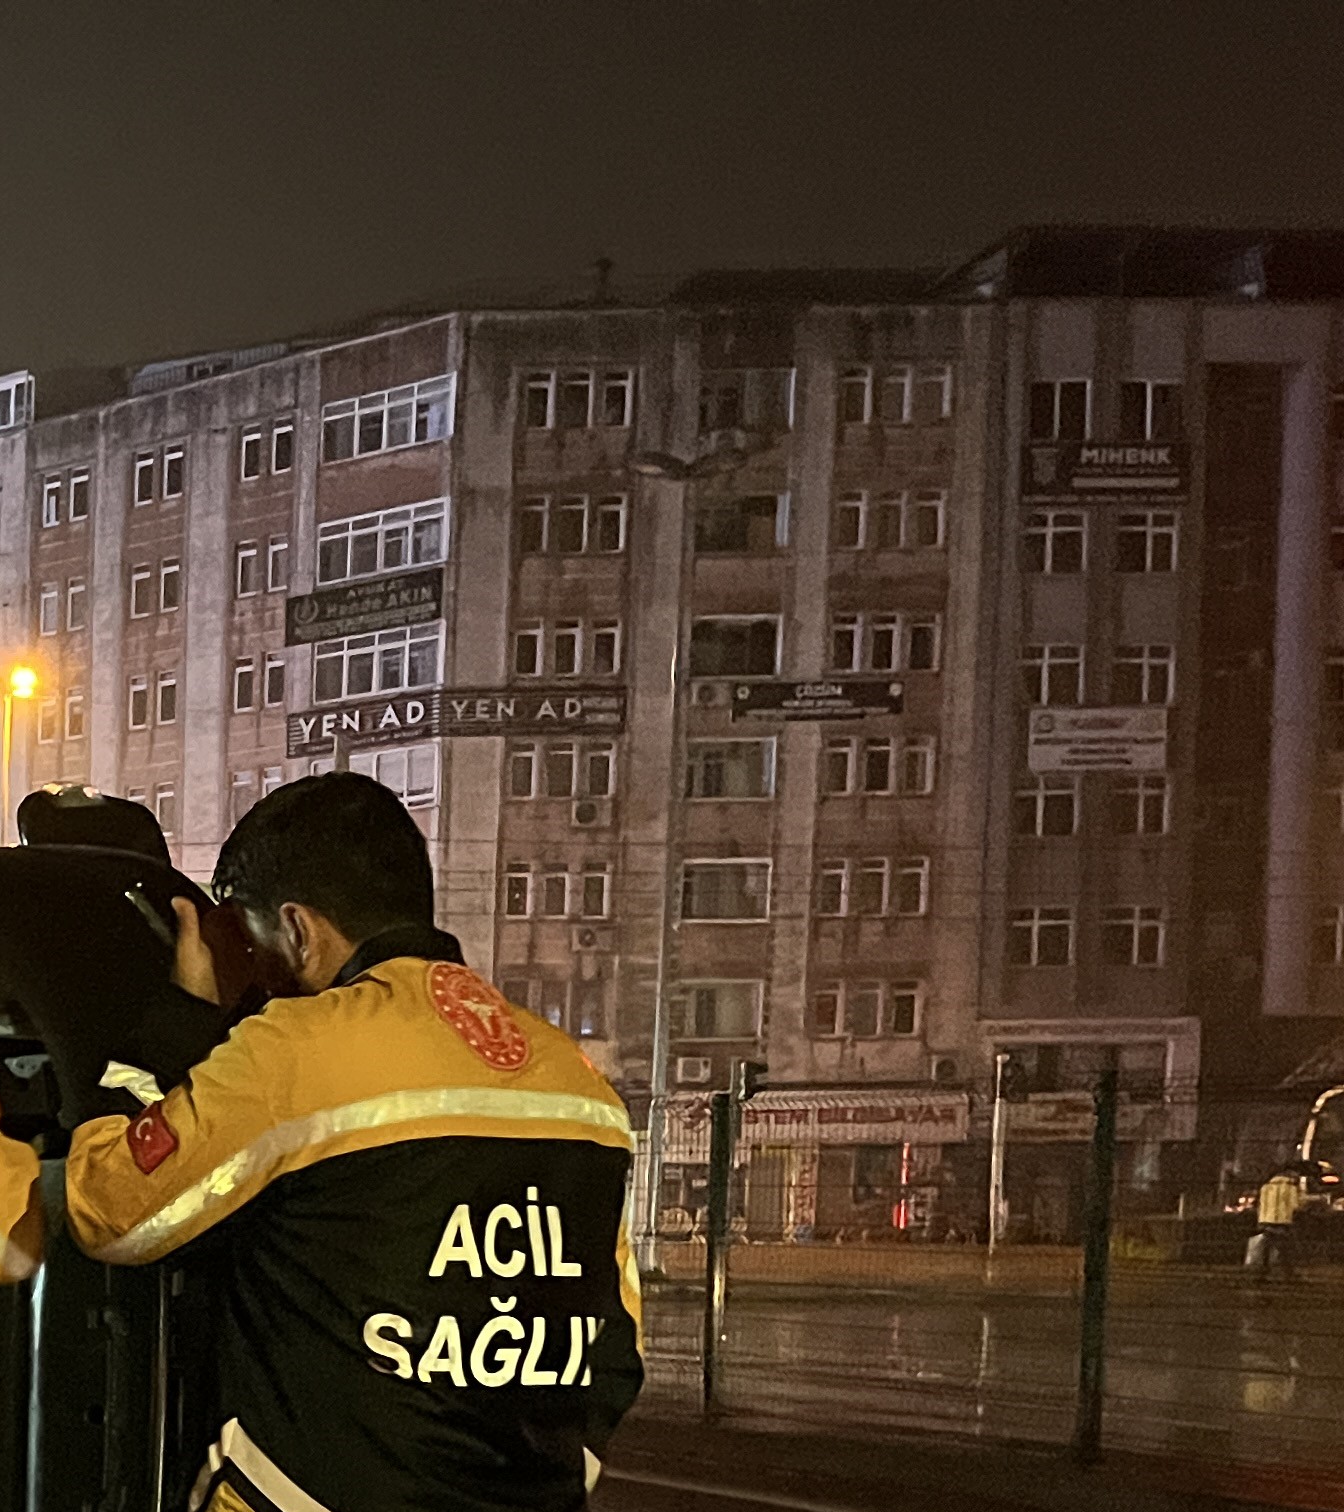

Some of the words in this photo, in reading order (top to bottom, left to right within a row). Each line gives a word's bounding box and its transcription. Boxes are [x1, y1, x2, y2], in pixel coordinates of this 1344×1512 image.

[298, 708, 361, 744] YEN
[379, 700, 425, 729] AD
[450, 697, 516, 722] YEN
[535, 697, 582, 720] AD
[428, 1186, 582, 1279] ACİL
